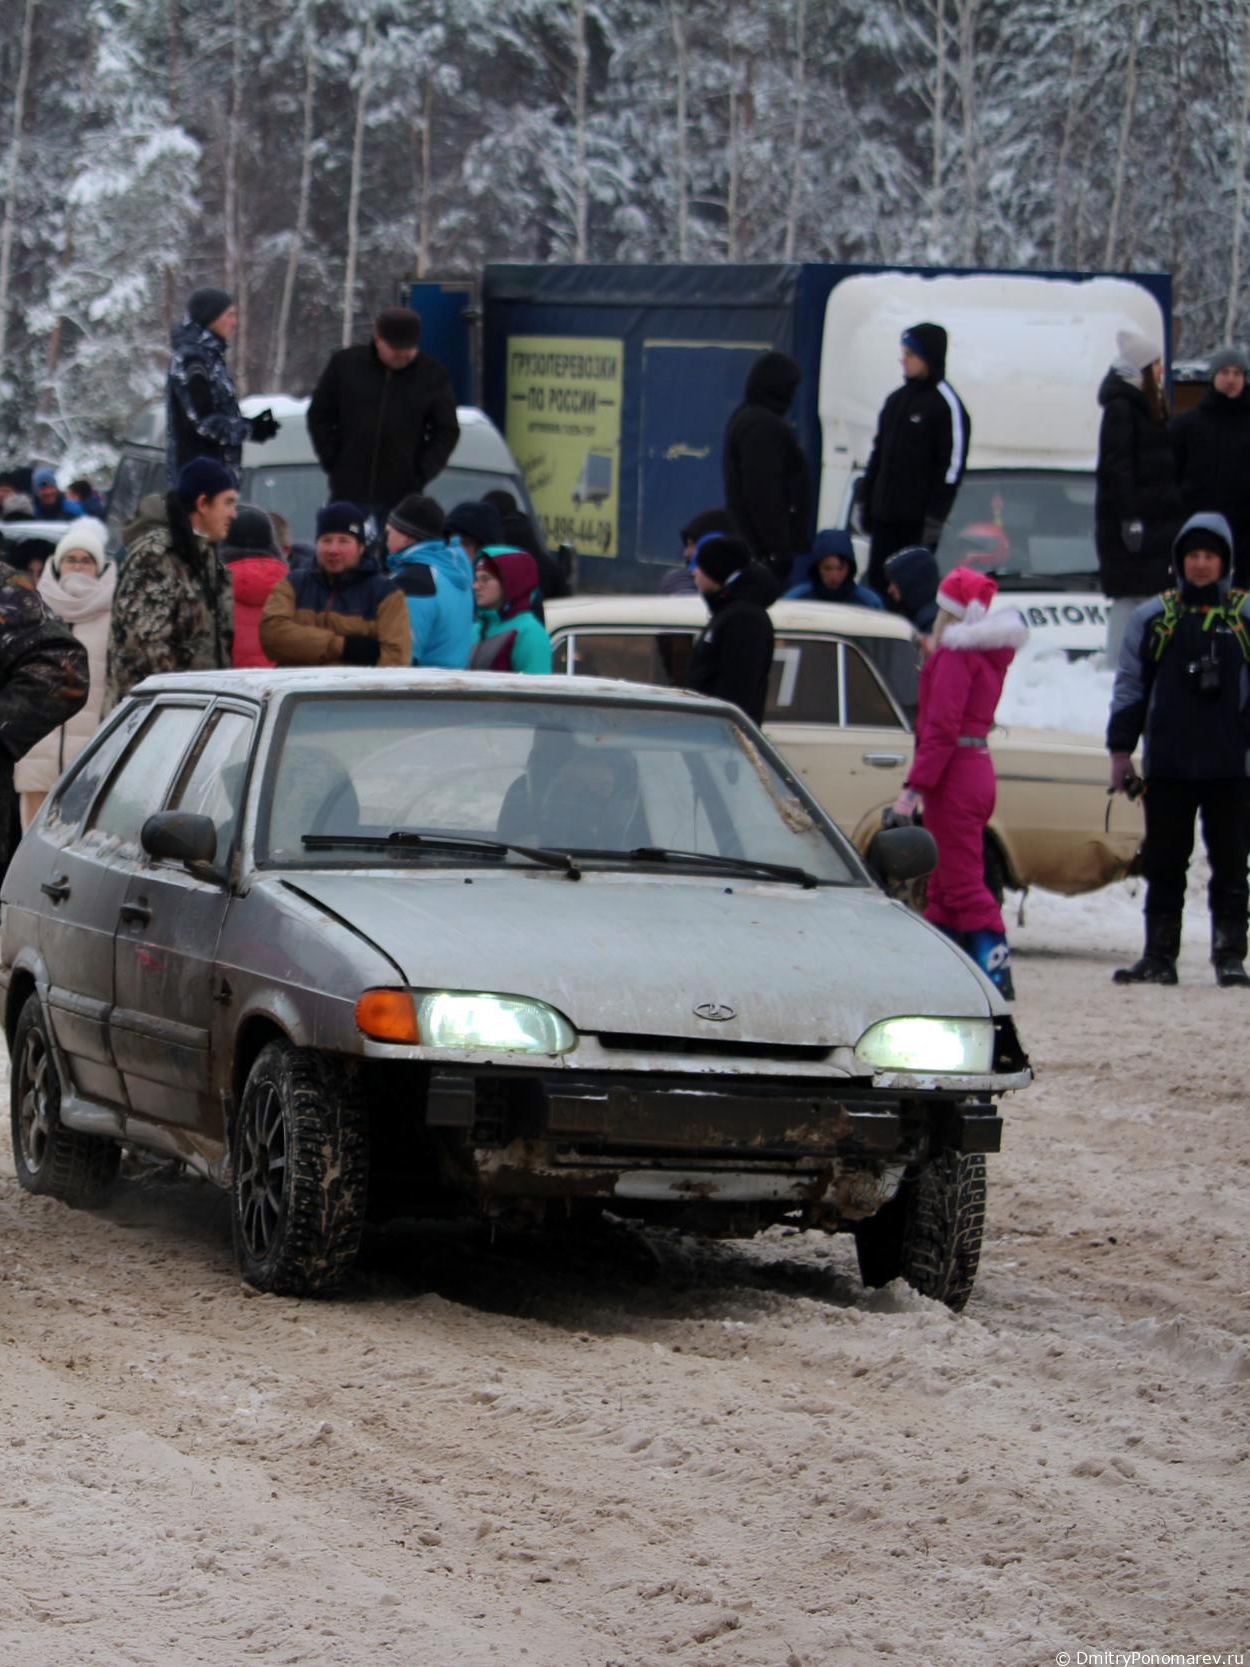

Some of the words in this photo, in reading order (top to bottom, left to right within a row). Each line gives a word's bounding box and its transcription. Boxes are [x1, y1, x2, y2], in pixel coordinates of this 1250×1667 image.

[511, 351, 616, 379] ГРУЗОПЕРЕВОЗКИ
[527, 386, 544, 411] ПО
[549, 387, 596, 415] РОССИИ
